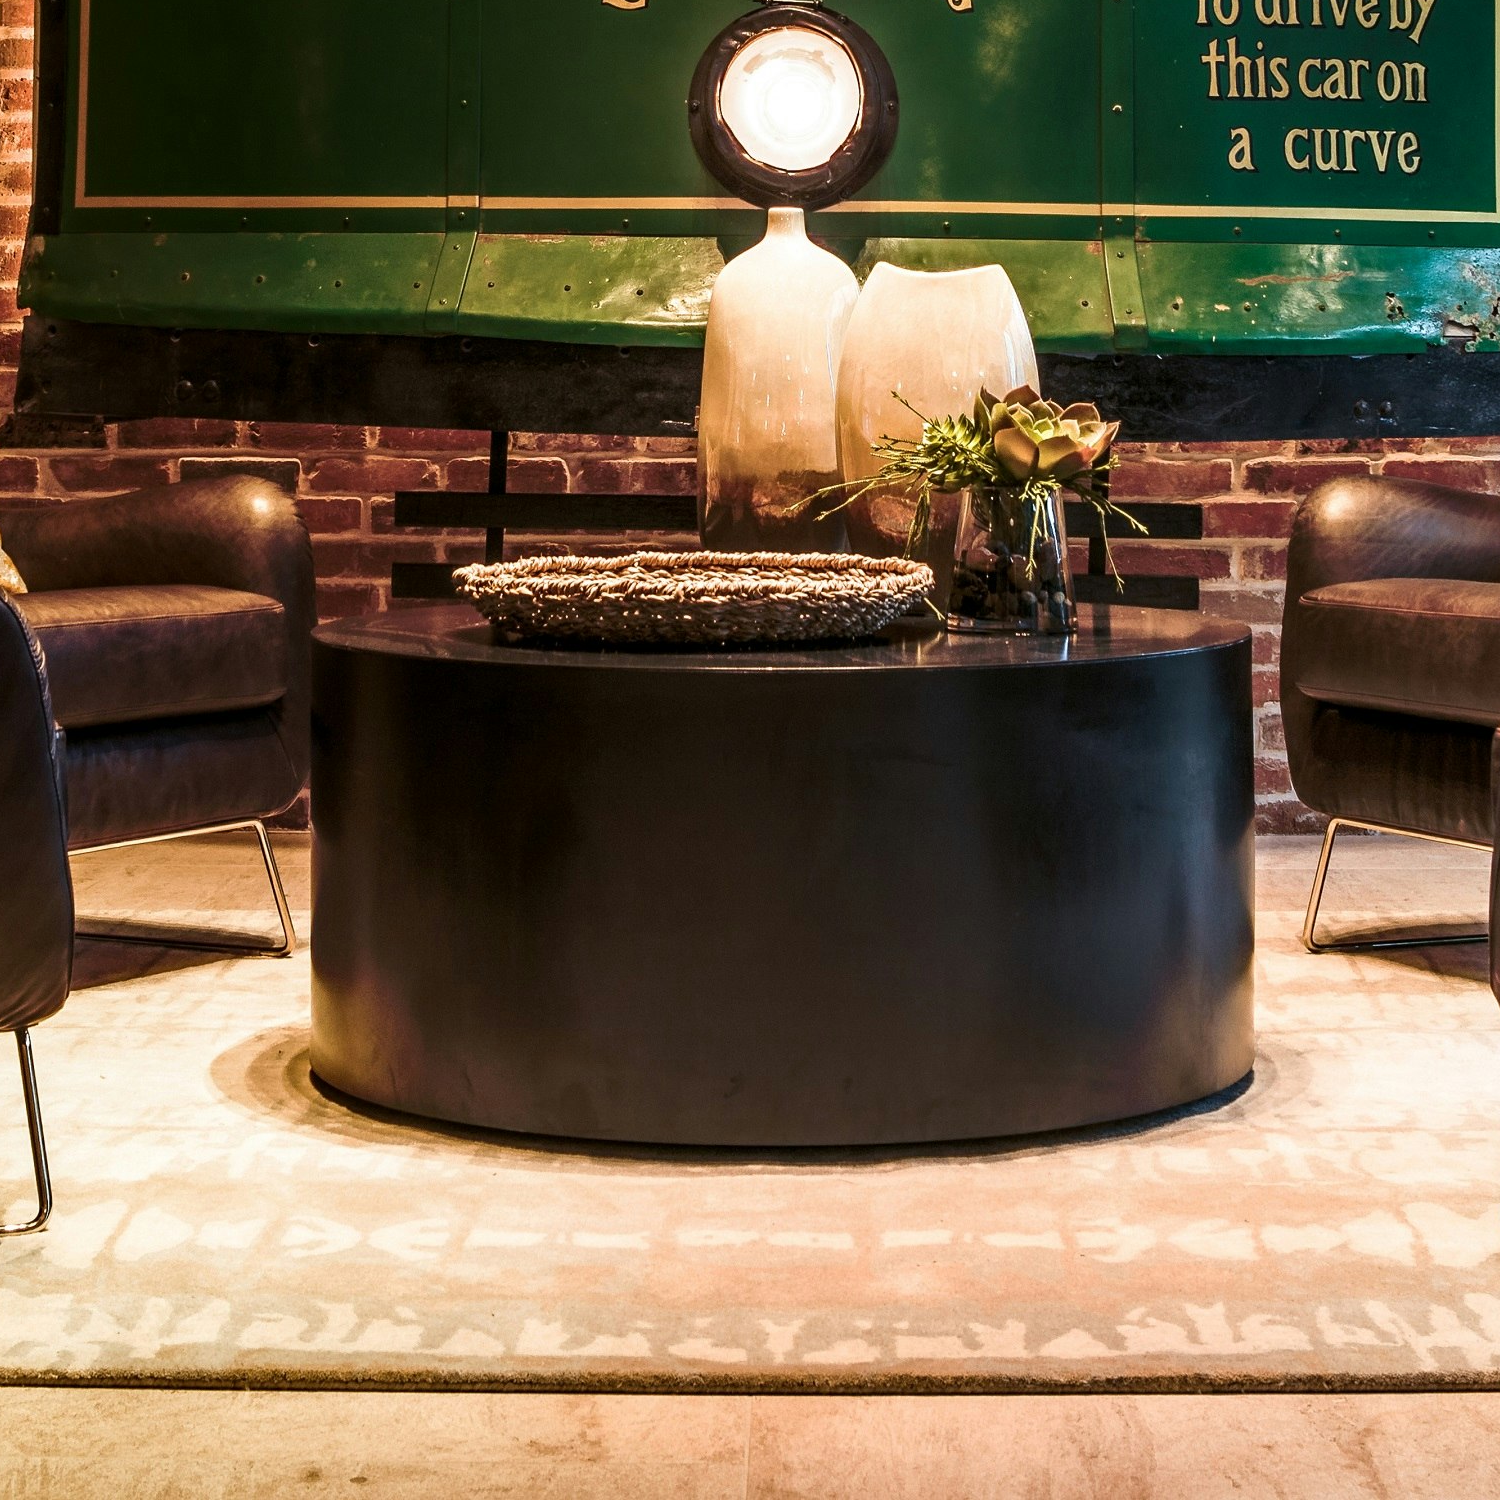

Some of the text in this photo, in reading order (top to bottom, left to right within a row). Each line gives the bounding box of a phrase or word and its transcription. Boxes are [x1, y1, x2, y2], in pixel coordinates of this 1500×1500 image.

[1200, 36, 1428, 103] this car on
[1227, 126, 1421, 174] a curve
